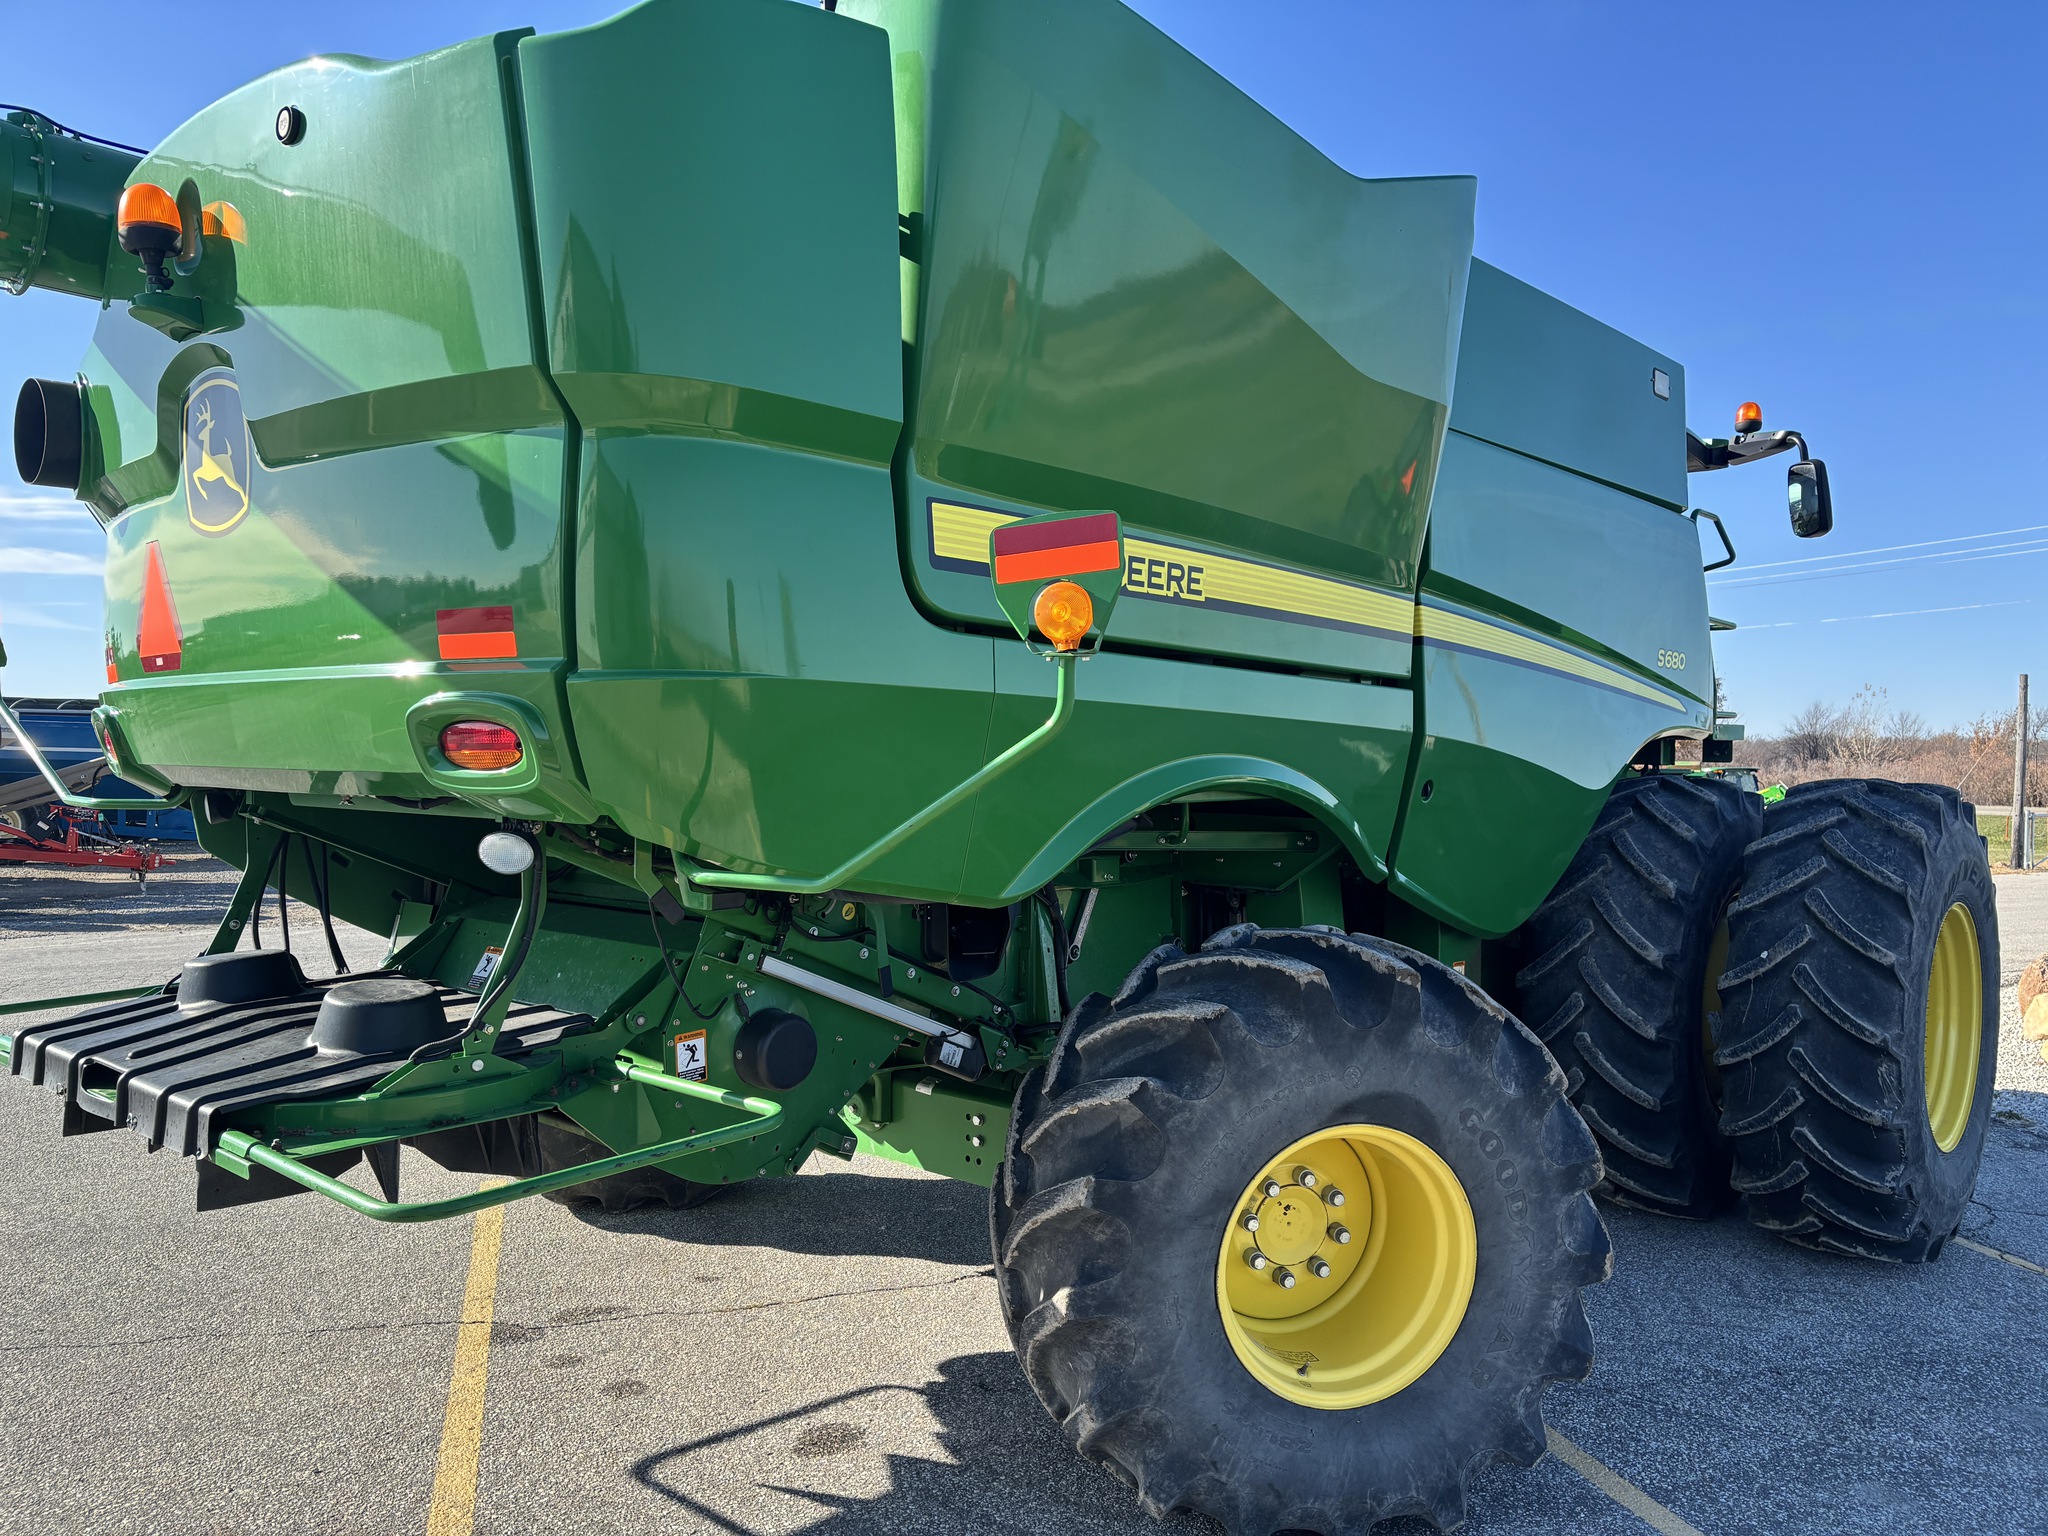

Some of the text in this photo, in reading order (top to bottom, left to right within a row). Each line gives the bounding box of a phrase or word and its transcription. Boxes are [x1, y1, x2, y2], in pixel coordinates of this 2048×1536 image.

[1123, 555, 1205, 597] EERE
[1657, 648, 1686, 670] S680
[683, 1031, 704, 1040] WARNING
[1459, 1107, 1534, 1390] GOODYEAR
